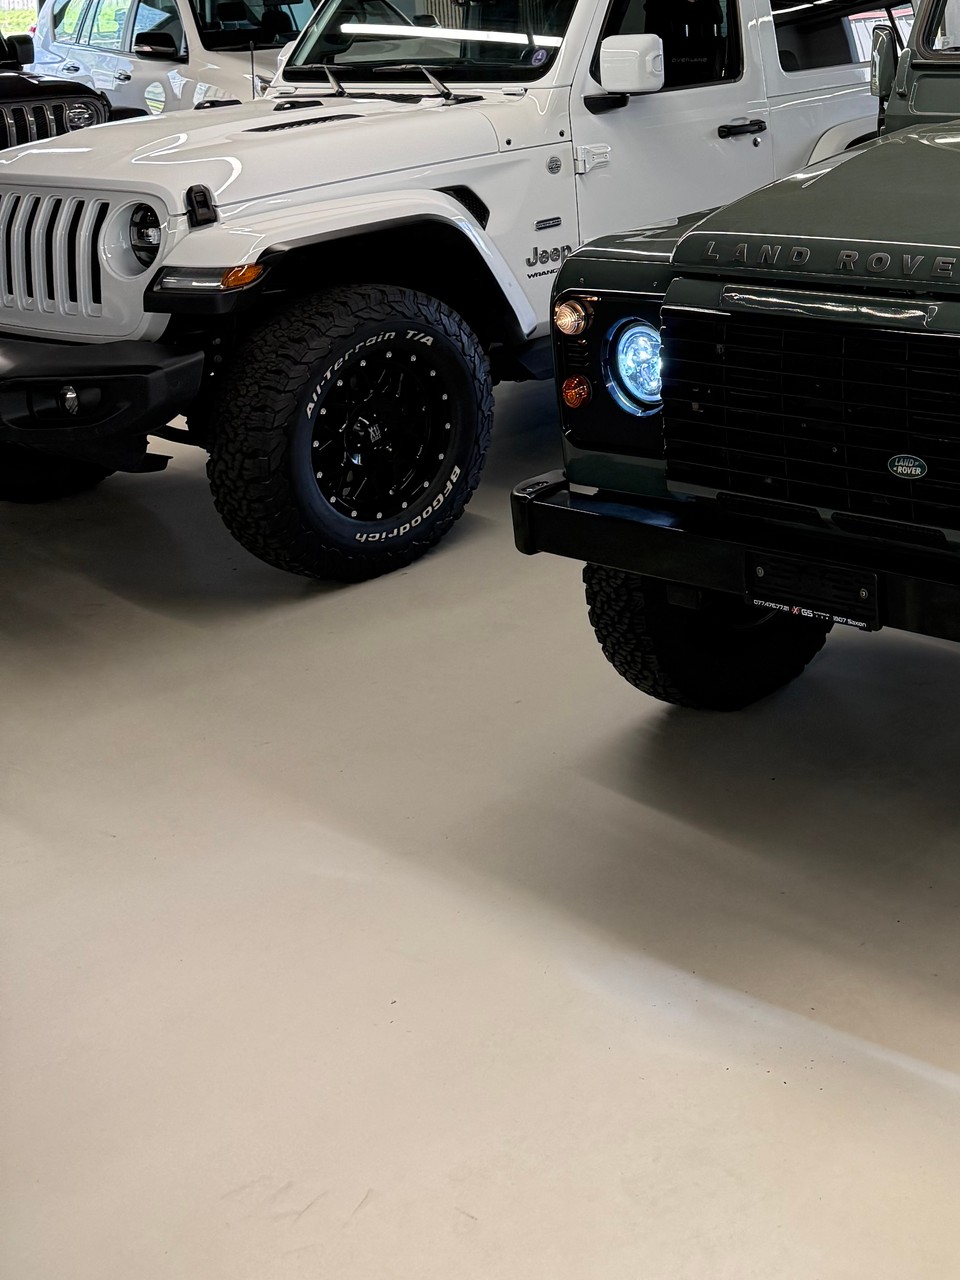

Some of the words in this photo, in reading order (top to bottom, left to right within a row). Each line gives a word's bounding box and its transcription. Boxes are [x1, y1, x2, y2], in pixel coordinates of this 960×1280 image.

[525, 245, 572, 267] Jeep
[703, 241, 811, 266] LAND
[527, 268, 560, 279] WRANG
[306, 331, 396, 419] All-Terrain
[405, 329, 434, 346] T/A
[895, 458, 914, 466] LAND
[897, 465, 921, 475] ROVER
[355, 465, 461, 542] BFGoodrich
